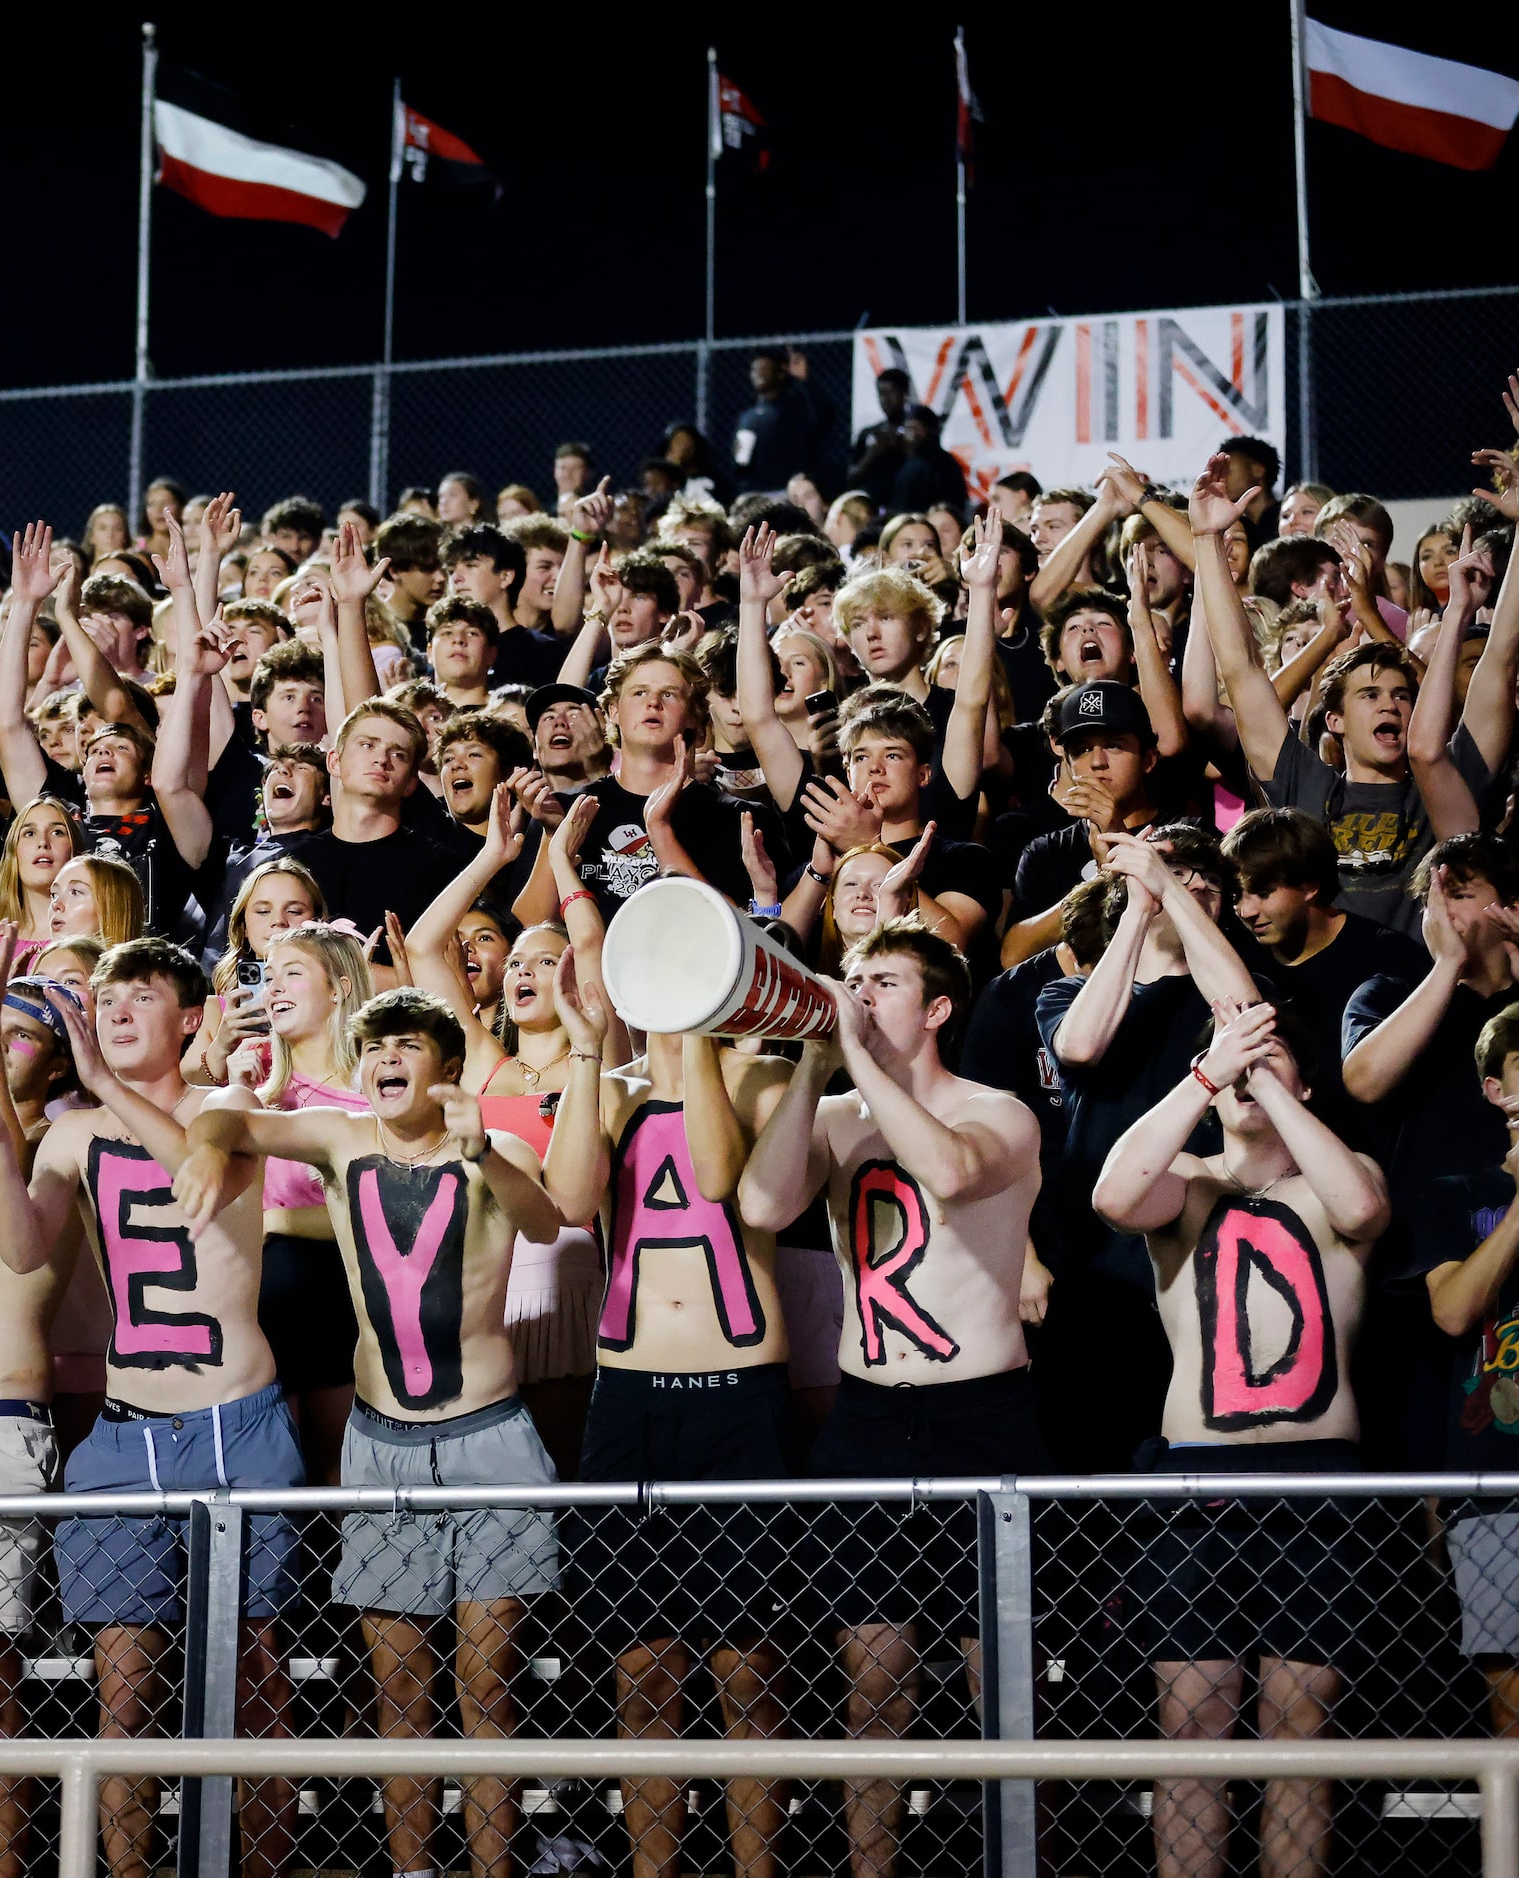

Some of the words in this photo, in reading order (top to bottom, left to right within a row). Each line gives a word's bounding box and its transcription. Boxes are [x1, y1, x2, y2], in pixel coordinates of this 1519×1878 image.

[863, 311, 1270, 450] WIN
[622, 828, 638, 838] LH
[86, 1133, 223, 1369] E
[346, 1154, 468, 1411] Y
[596, 1099, 765, 1352] A
[847, 1157, 960, 1367] R
[1194, 1193, 1339, 1433] D
[652, 1373, 739, 1389] HANES
